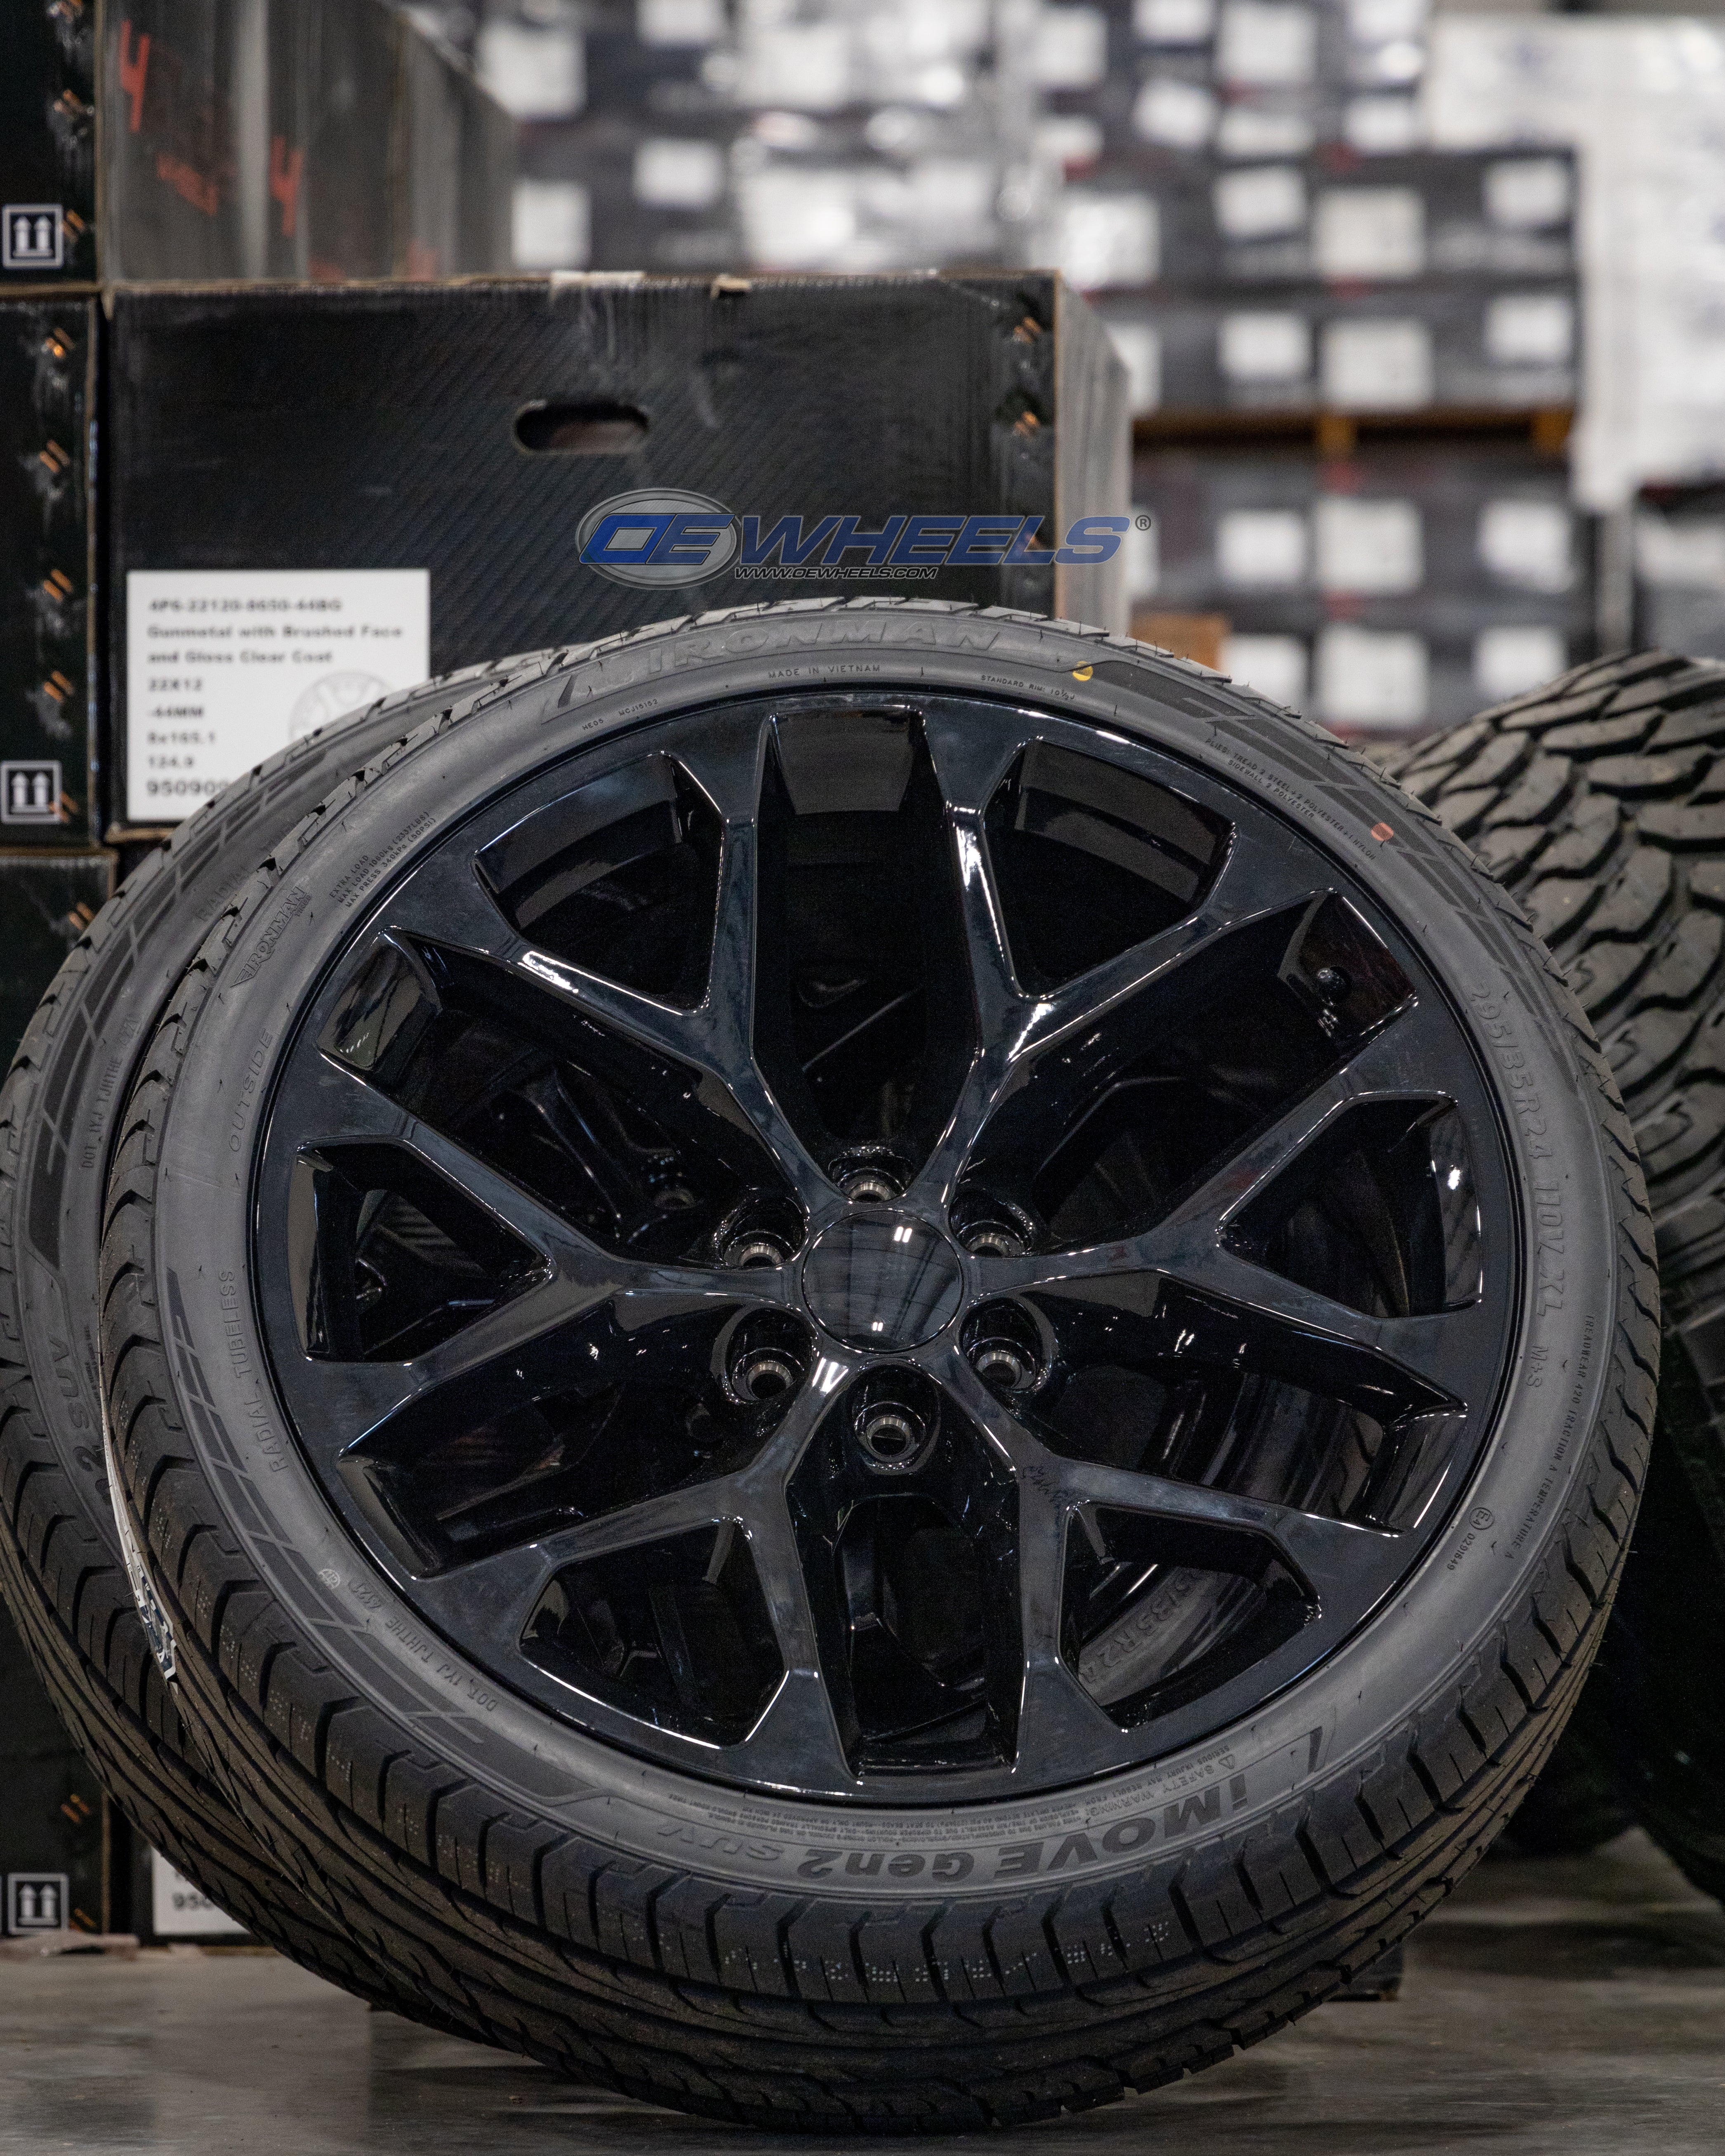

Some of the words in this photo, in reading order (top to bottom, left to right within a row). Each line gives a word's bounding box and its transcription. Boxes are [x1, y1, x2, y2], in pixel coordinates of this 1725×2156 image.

[148, 624, 232, 638] Gunmetal
[240, 625, 274, 638] with
[282, 624, 354, 638] Brushed
[361, 624, 402, 638] Face
[648, 620, 999, 674] IRONMAN
[148, 650, 179, 663] and
[186, 649, 233, 663] Gloss
[240, 649, 285, 663] Clear
[292, 649, 332, 663] Coat
[768, 667, 800, 680] MADE
[808, 666, 820, 675] IN
[828, 663, 880, 675] VIETNAM
[980, 674, 1024, 688] STANDARD
[1029, 683, 1046, 692] RIM:
[1228, 759, 1263, 784] SIDEWALL
[1273, 787, 1315, 819] POLYESTER
[1231, 752, 1258, 771] TREAD
[1352, 839, 1376, 861] NYLON
[329, 874, 352, 898] EXTRA
[349, 853, 370, 874] LOAD
[336, 886, 353, 903] MAX
[350, 867, 371, 887] LOAD
[368, 843, 395, 869] 1060kg
[344, 891, 361, 908] MAX
[358, 867, 382, 892] PRESS
[379, 842, 408, 868] 340kPa
[406, 815, 438, 843] (50PSI)
[240, 885, 309, 975] IRONMAN
[227, 1027, 275, 1153] OUTSIDE
[80, 1143, 98, 1169] DOT
[1534, 1268, 1566, 1320] XL
[218, 1269, 252, 1379] TUBELESS
[1577, 1315, 1595, 1378] TREADWEAR
[1525, 1345, 1549, 1389] M+S
[1569, 1382, 1585, 1404] 420
[242, 1390, 289, 1473] RADIAL
[1552, 1409, 1577, 1462] TRACTION
[1547, 1463, 1559, 1473] A
[1511, 1477, 1554, 1549] TEMPERATURE
[1503, 1550, 1515, 1560] A
[465, 1684, 500, 1713] DOT
[1159, 1763, 1216, 1794] SAFETY
[659, 1823, 780, 1861] SUV
[997, 1772, 1247, 1875] iMOVE
[799, 1847, 976, 1883] Gen2
